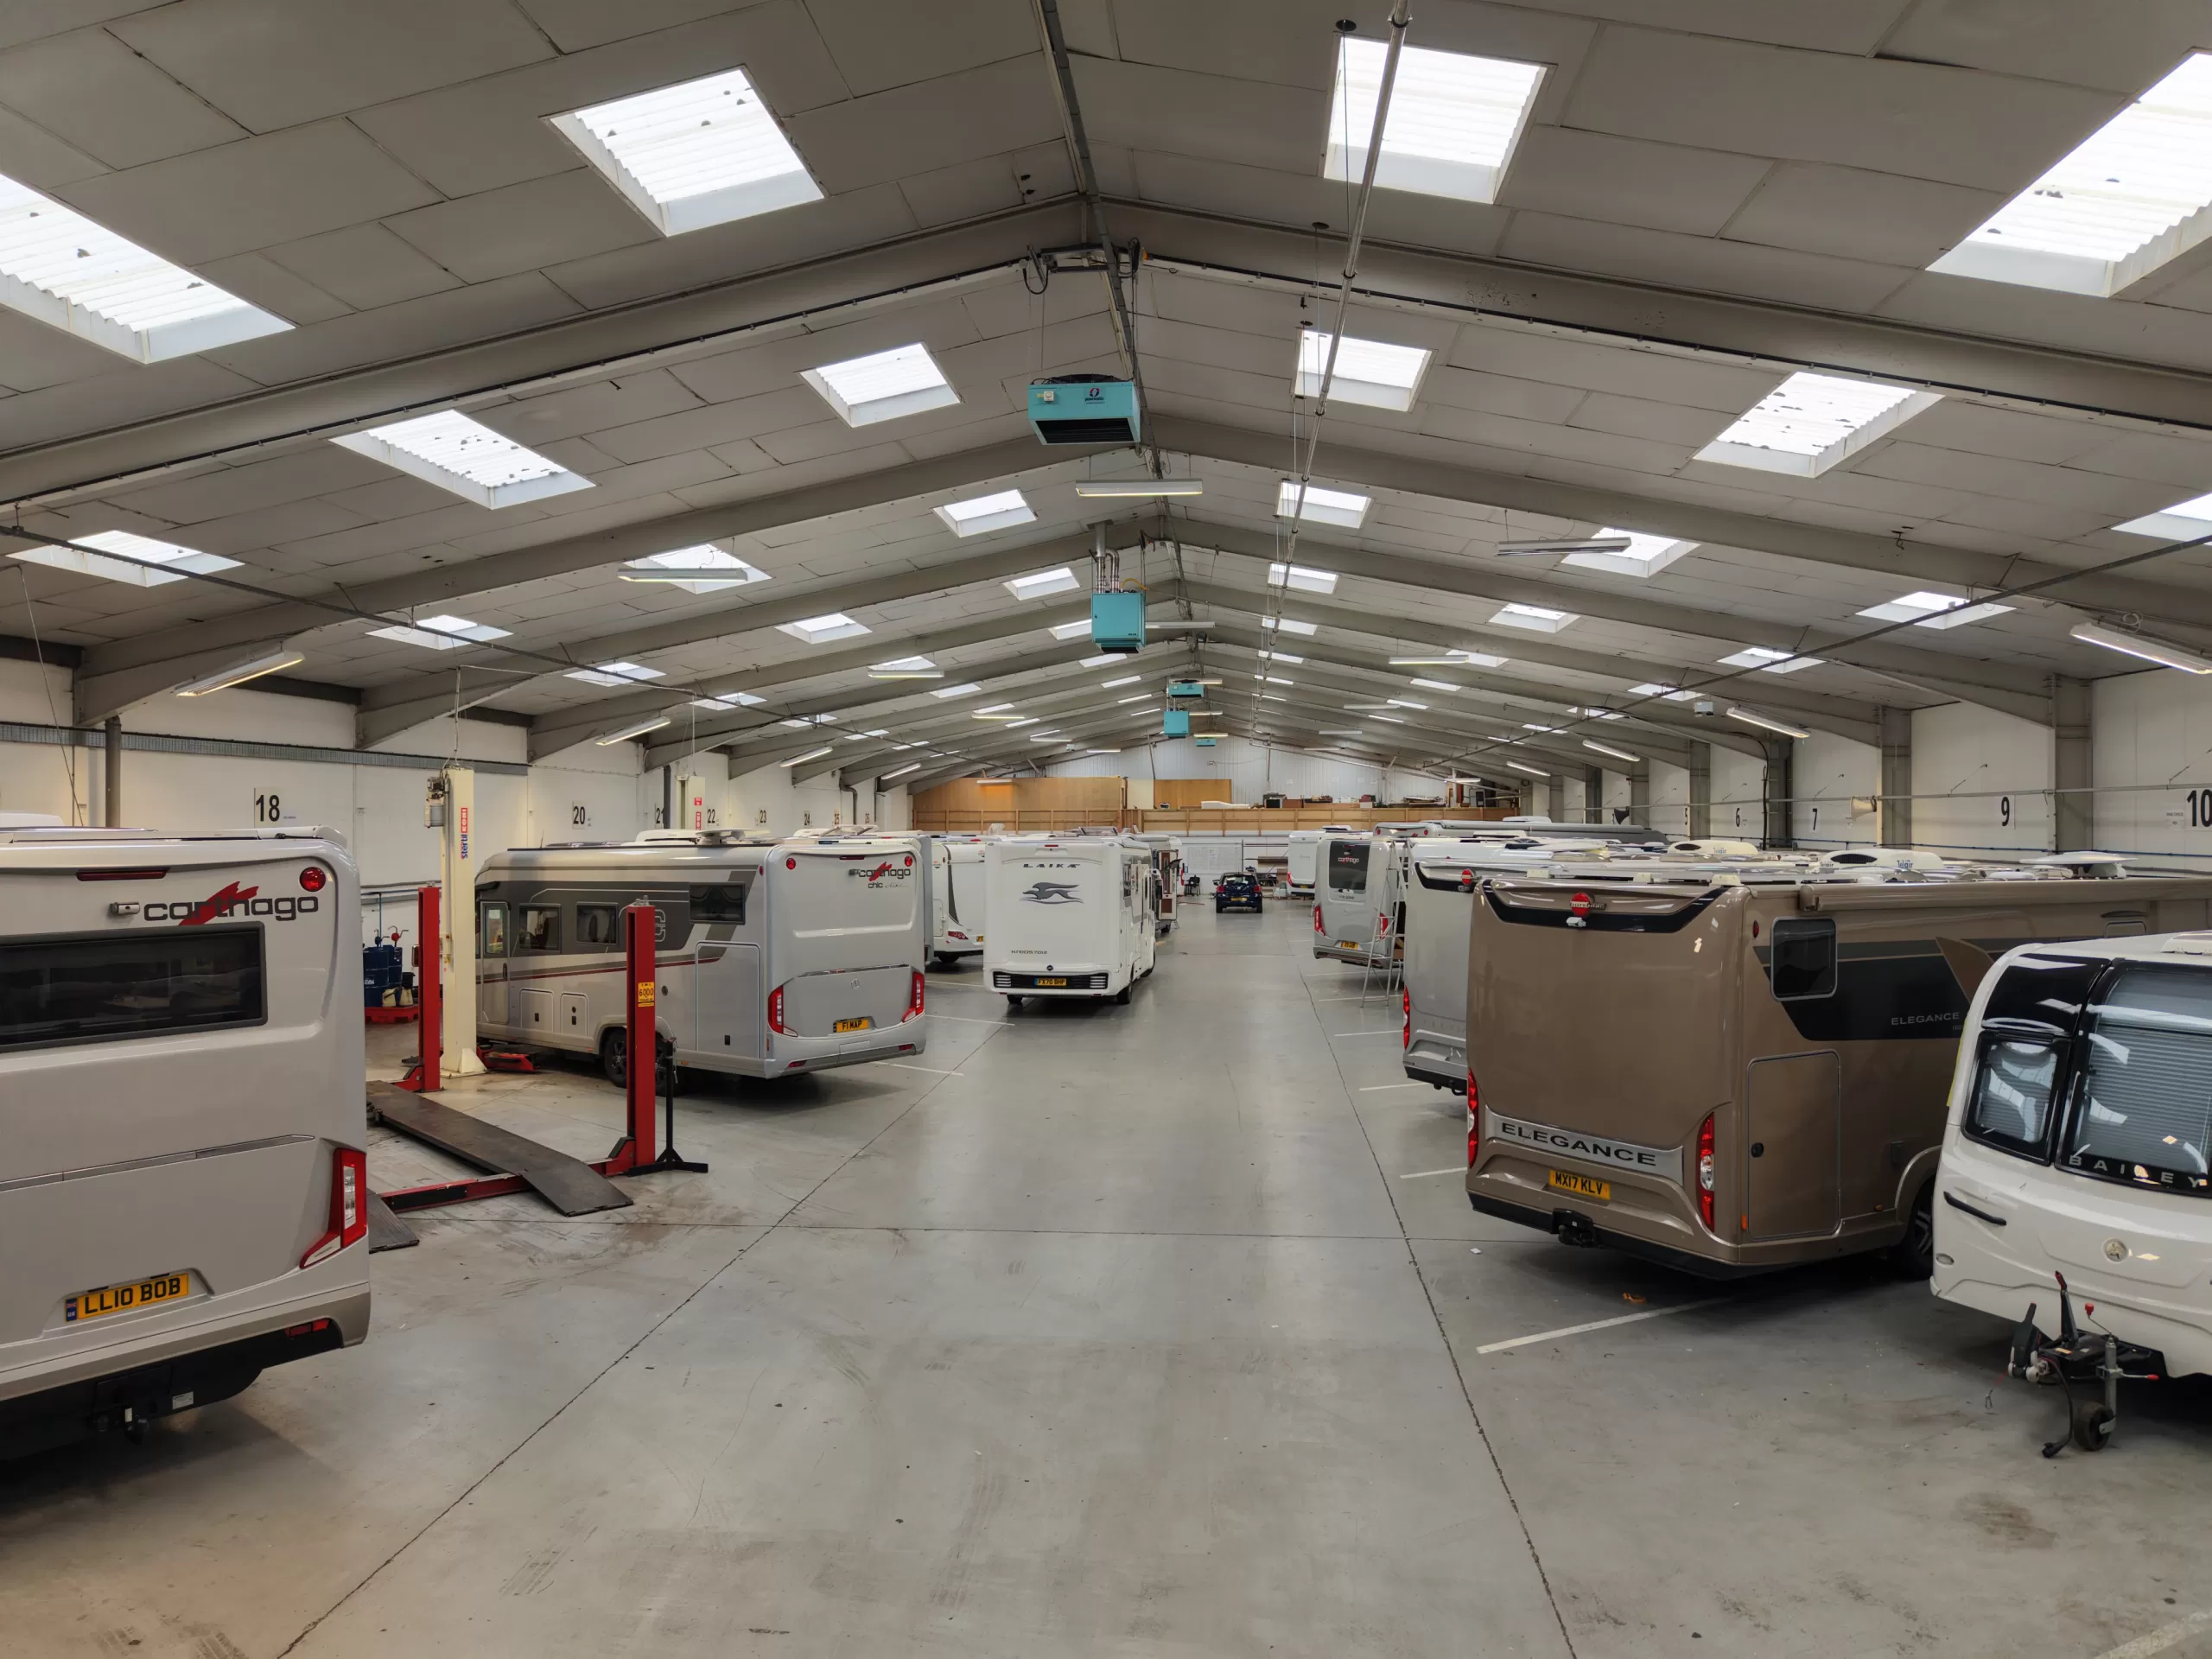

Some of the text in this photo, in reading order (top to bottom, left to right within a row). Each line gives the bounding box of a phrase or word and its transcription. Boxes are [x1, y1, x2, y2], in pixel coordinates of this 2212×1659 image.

[256, 795, 280, 822] 18
[573, 806, 586, 824] 20
[708, 809, 715, 823] 22
[760, 810, 767, 823] 23
[1735, 807, 1741, 827] 6
[1812, 808, 1818, 830] 7
[2001, 797, 2010, 827] 9
[2187, 789, 2212, 827] 10
[858, 868, 911, 880] carthago
[144, 895, 319, 922] carthago
[639, 988, 654, 997] 6000
[849, 1020, 862, 1029] MAP
[1891, 1012, 1960, 1026] ELEGANCE
[1502, 1122, 1656, 1166] ELEGANCE
[2069, 1155, 2206, 1188] BAIEY
[1555, 1172, 1603, 1195] MX17 KLV
[85, 1277, 181, 1314] LL10 BOB
